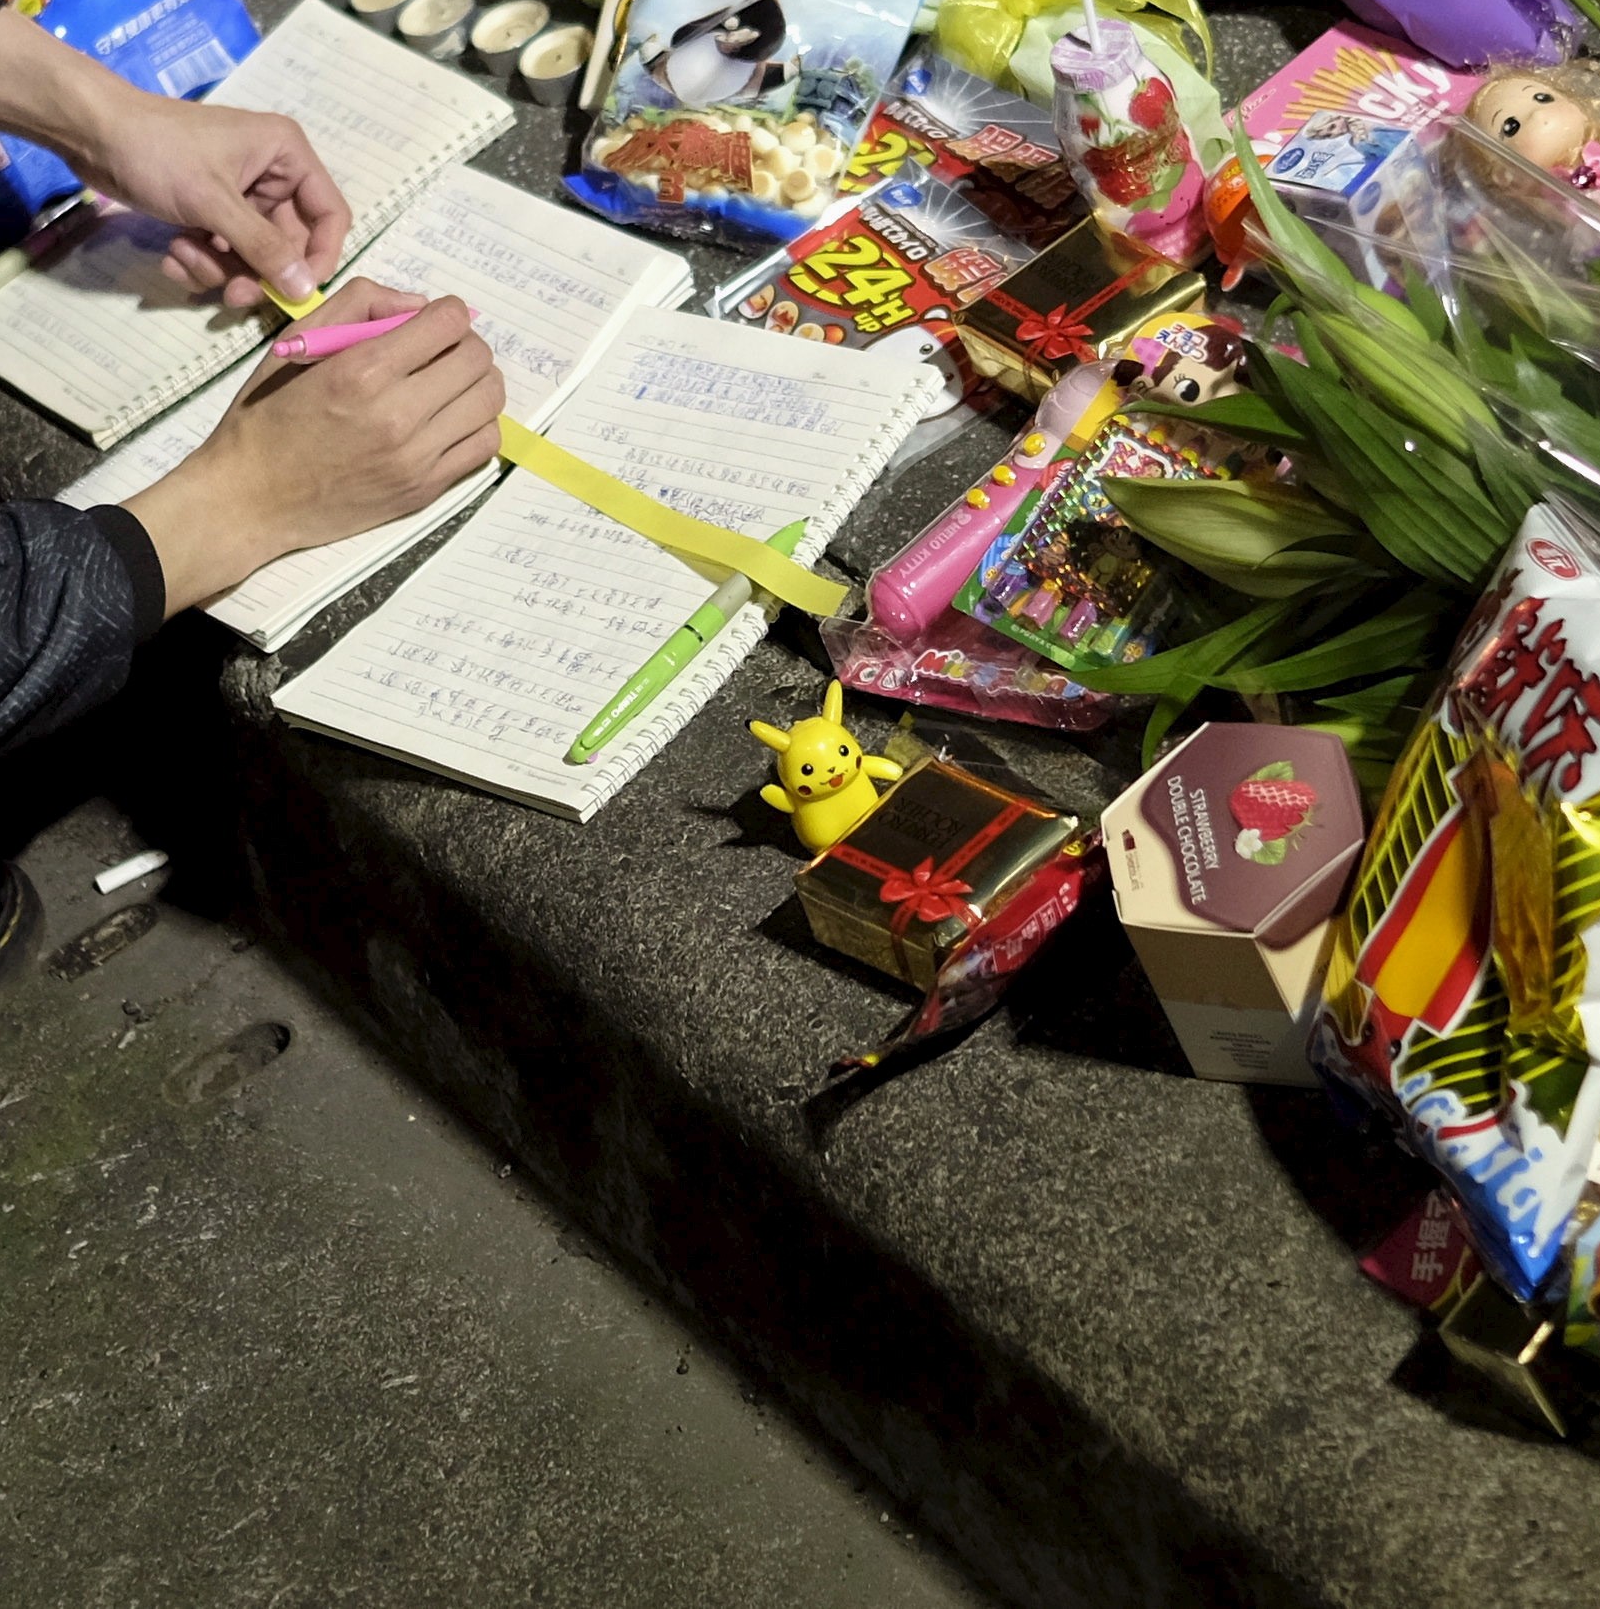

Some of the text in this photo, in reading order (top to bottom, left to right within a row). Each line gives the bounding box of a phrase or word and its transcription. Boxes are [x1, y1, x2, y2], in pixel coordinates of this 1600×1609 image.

[898, 520, 965, 580] HELLO KITTY
[1167, 775, 1207, 906] DOUBLE CHOCOLATE
[1189, 788, 1220, 871] STRAWBERRY
